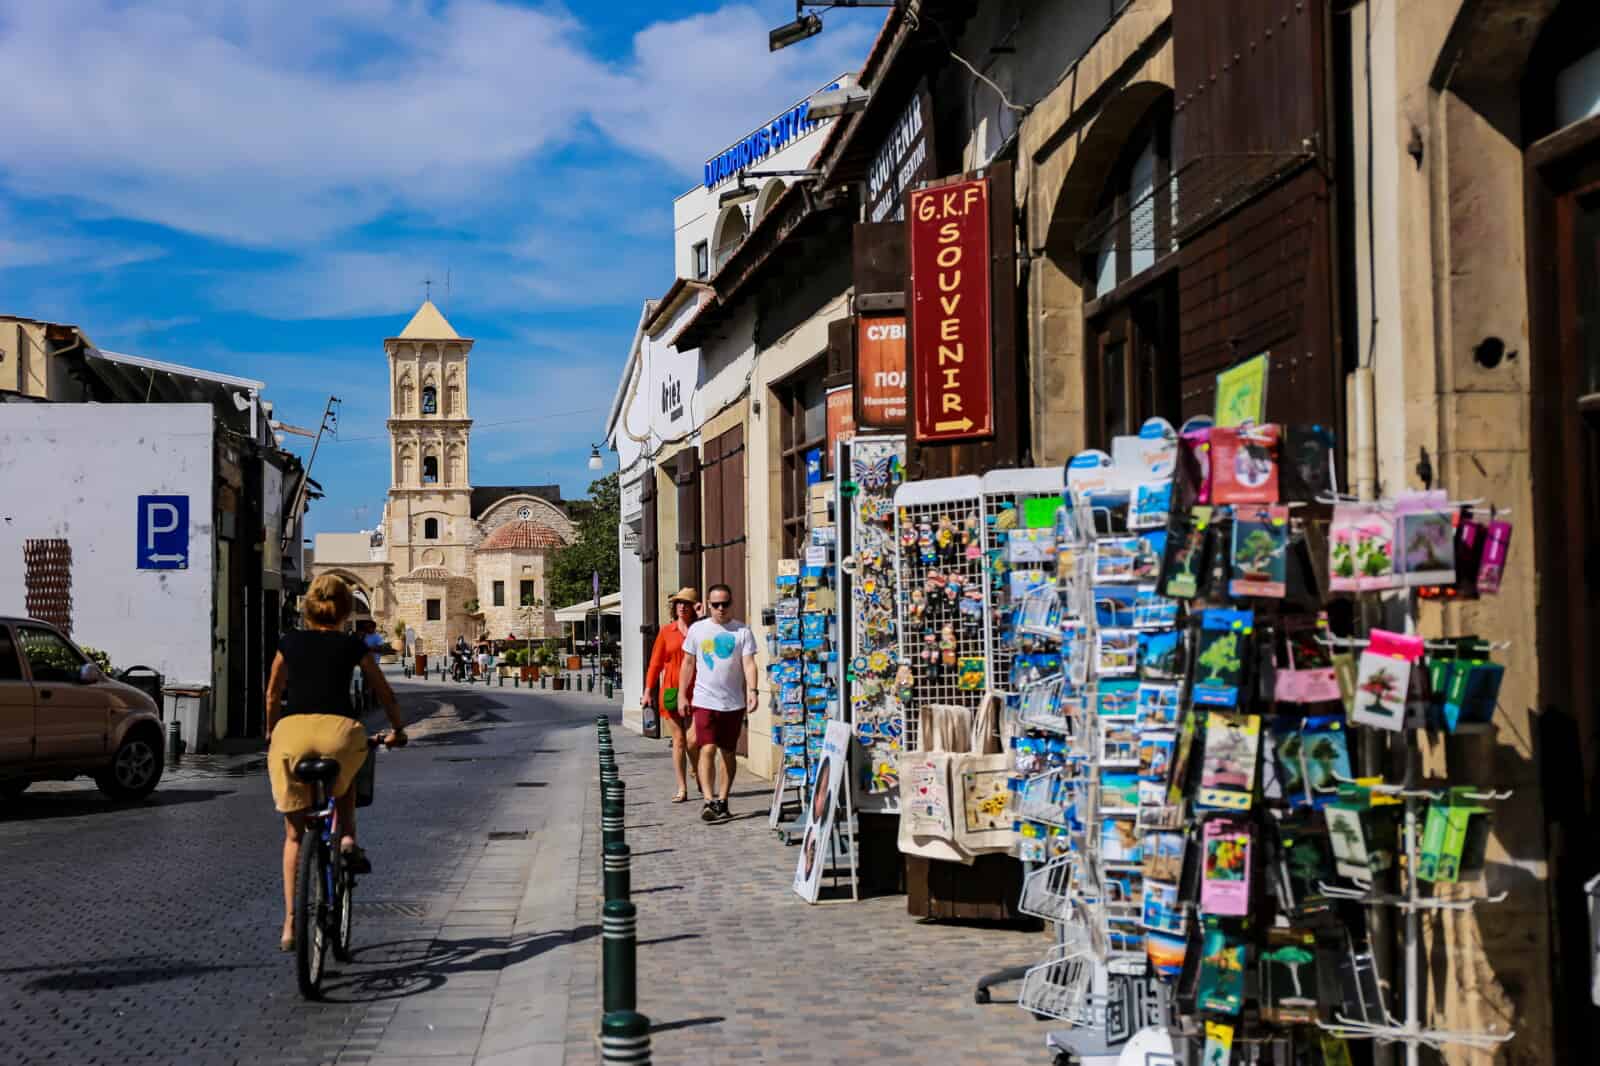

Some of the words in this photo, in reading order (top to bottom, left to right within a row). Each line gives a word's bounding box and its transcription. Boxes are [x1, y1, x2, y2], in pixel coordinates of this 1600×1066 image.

[870, 94, 922, 202] SOUVENIR
[918, 188, 979, 221] G.K.F
[936, 222, 965, 414] SOUVENIR
[147, 503, 179, 550] P
